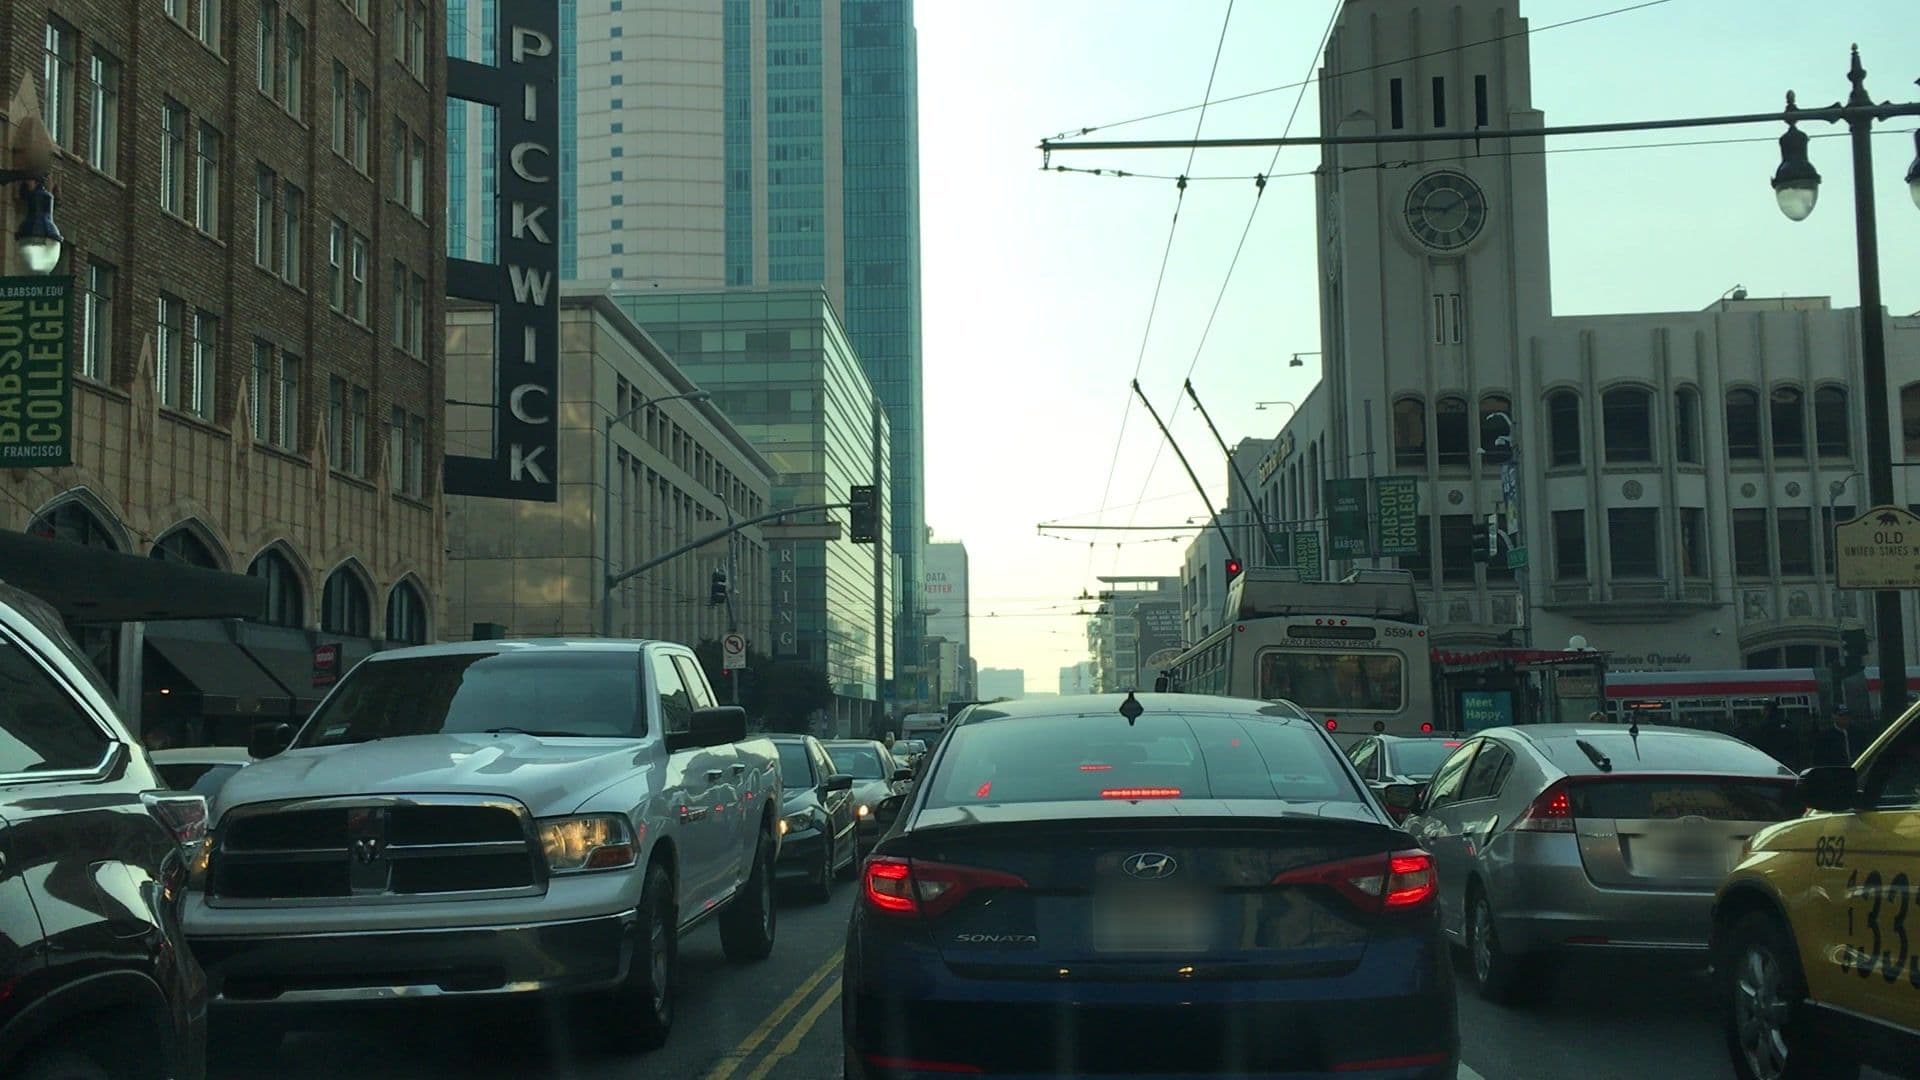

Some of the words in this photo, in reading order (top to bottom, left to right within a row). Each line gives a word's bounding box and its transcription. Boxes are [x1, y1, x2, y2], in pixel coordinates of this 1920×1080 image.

[508, 23, 553, 485] PICKWICK
[0, 300, 24, 444] BABSON
[27, 299, 64, 442] COLLEGE
[4, 445, 63, 457] FRANCISCO
[1380, 485, 1399, 548] BABSON
[1399, 485, 1417, 546] COLLEGE
[1873, 531, 1904, 545] OLD
[1844, 546, 1875, 557] UNITED
[1879, 546, 1909, 557] STATES
[1384, 627, 1413, 638] 5594
[1465, 697, 1493, 708] Meet
[1466, 710, 1504, 722] Happy.
[1816, 835, 1846, 868] 852
[955, 933, 1037, 943] SONATA
